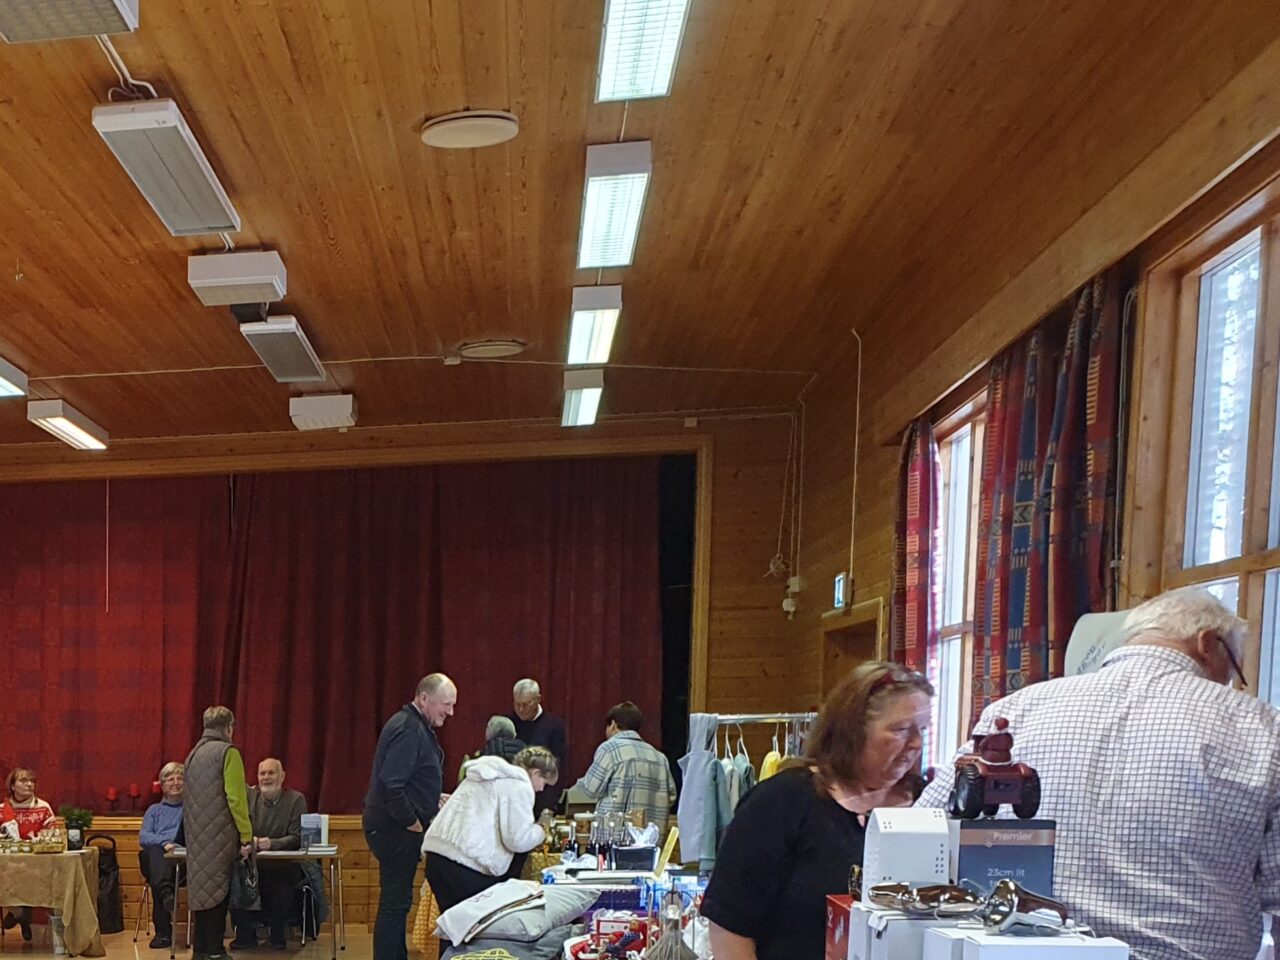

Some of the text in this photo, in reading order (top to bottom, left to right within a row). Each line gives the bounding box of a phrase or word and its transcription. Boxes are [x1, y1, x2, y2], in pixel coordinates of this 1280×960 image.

[993, 831, 1033, 841] Premier
[987, 868, 1025, 877] 23cm lit
